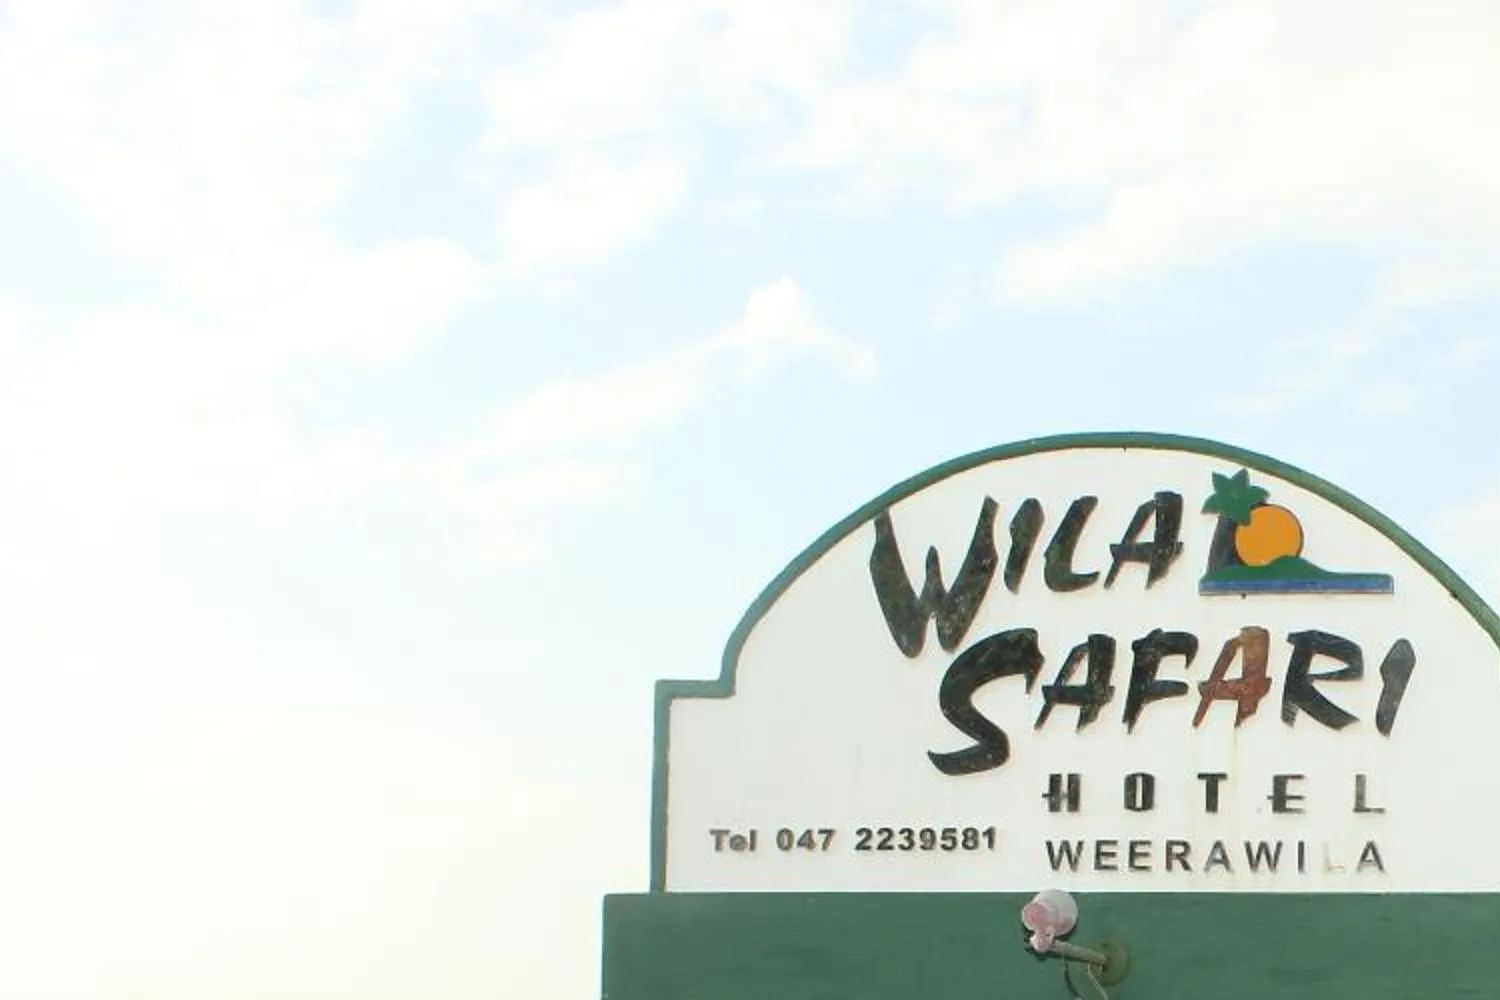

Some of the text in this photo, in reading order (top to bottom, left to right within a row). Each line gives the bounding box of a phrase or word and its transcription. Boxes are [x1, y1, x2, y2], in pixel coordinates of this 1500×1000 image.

[869, 491, 1184, 659] WILA
[928, 626, 1416, 776] SAFARI
[1043, 773, 1385, 814] HOTEL
[709, 826, 997, 852] Tel 047 2239581
[1046, 840, 1386, 874] WEERAWILA
